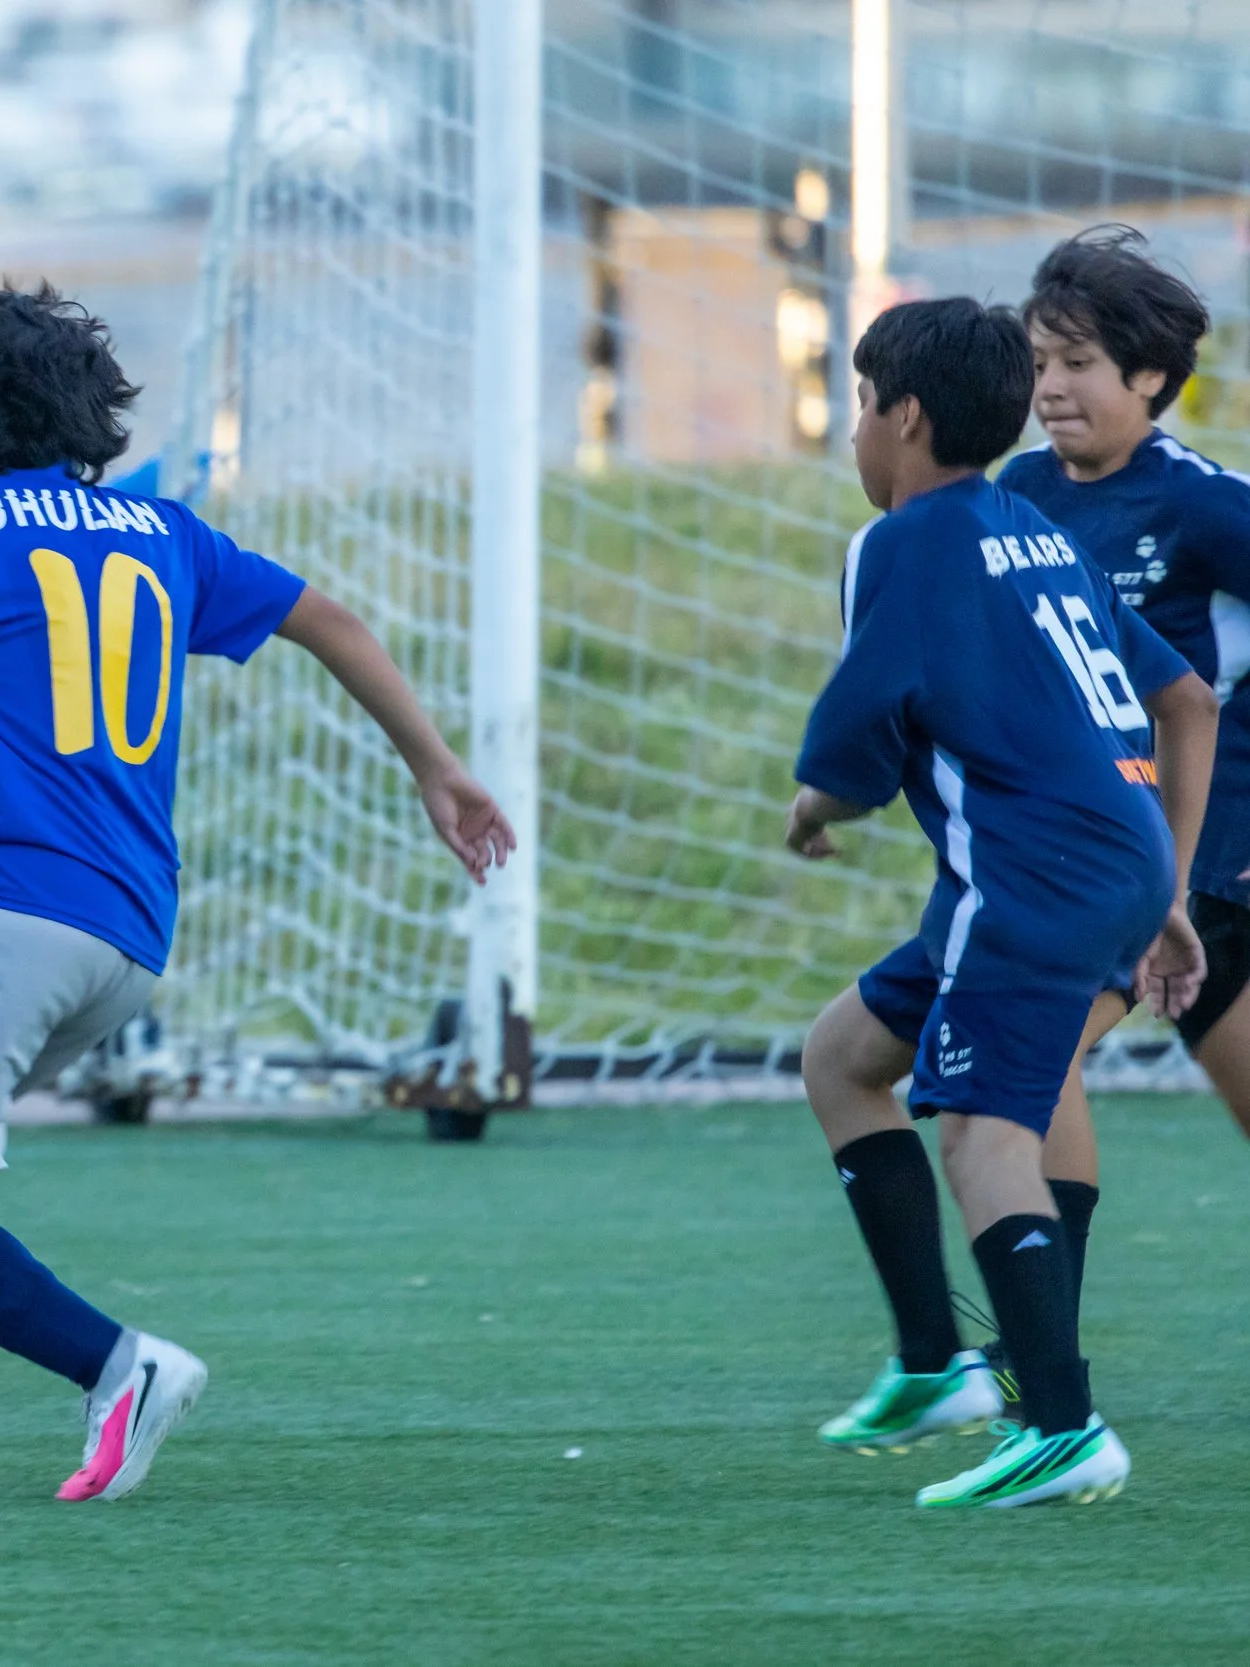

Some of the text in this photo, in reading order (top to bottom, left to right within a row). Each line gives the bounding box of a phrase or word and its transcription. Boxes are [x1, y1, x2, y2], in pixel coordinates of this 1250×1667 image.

[979, 532, 1076, 578] BEARS
[29, 548, 173, 765] 10
[1032, 593, 1149, 732] 16
